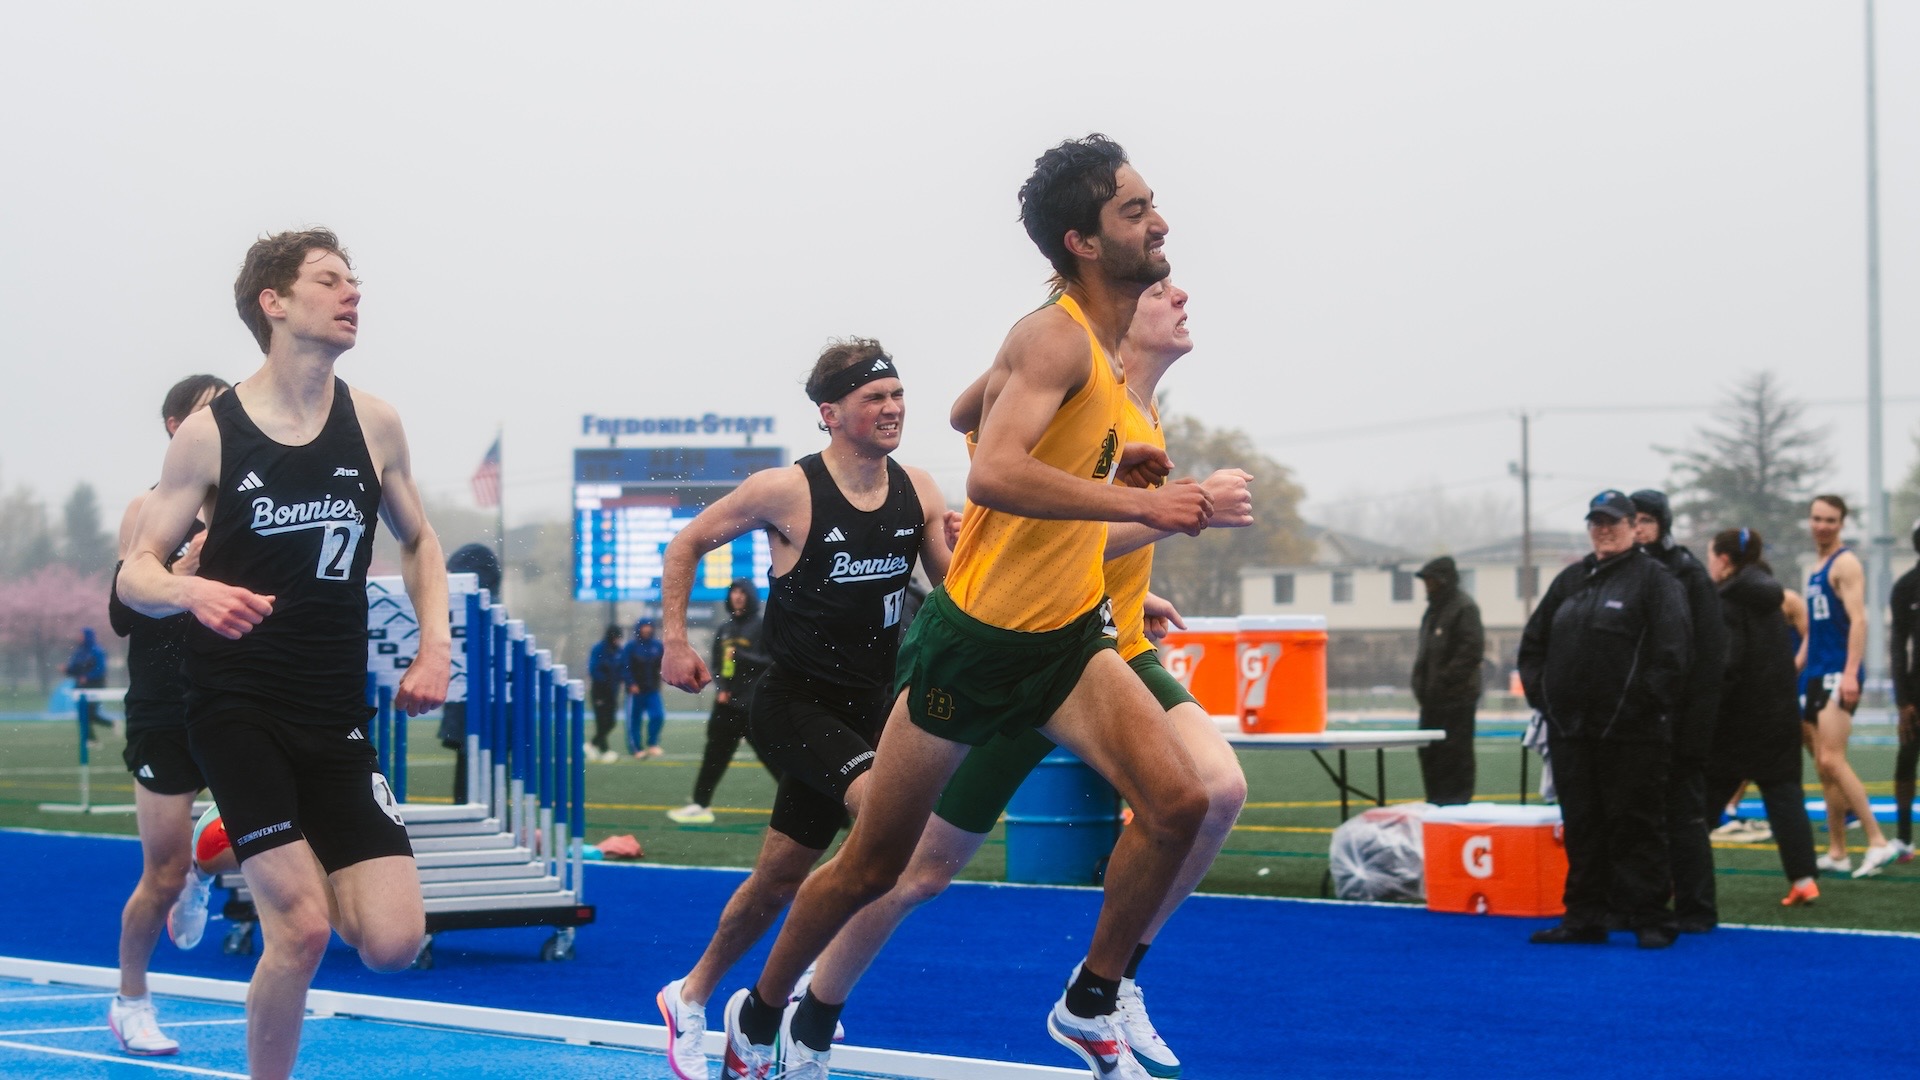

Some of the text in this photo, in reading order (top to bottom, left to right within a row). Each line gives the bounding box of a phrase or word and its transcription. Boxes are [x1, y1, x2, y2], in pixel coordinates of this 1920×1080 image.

[250, 493, 363, 533] Bonnies
[829, 552, 909, 581] Bonnies
[1166, 649, 1188, 679] G
[1241, 648, 1265, 679] G
[1462, 835, 1494, 880] G
